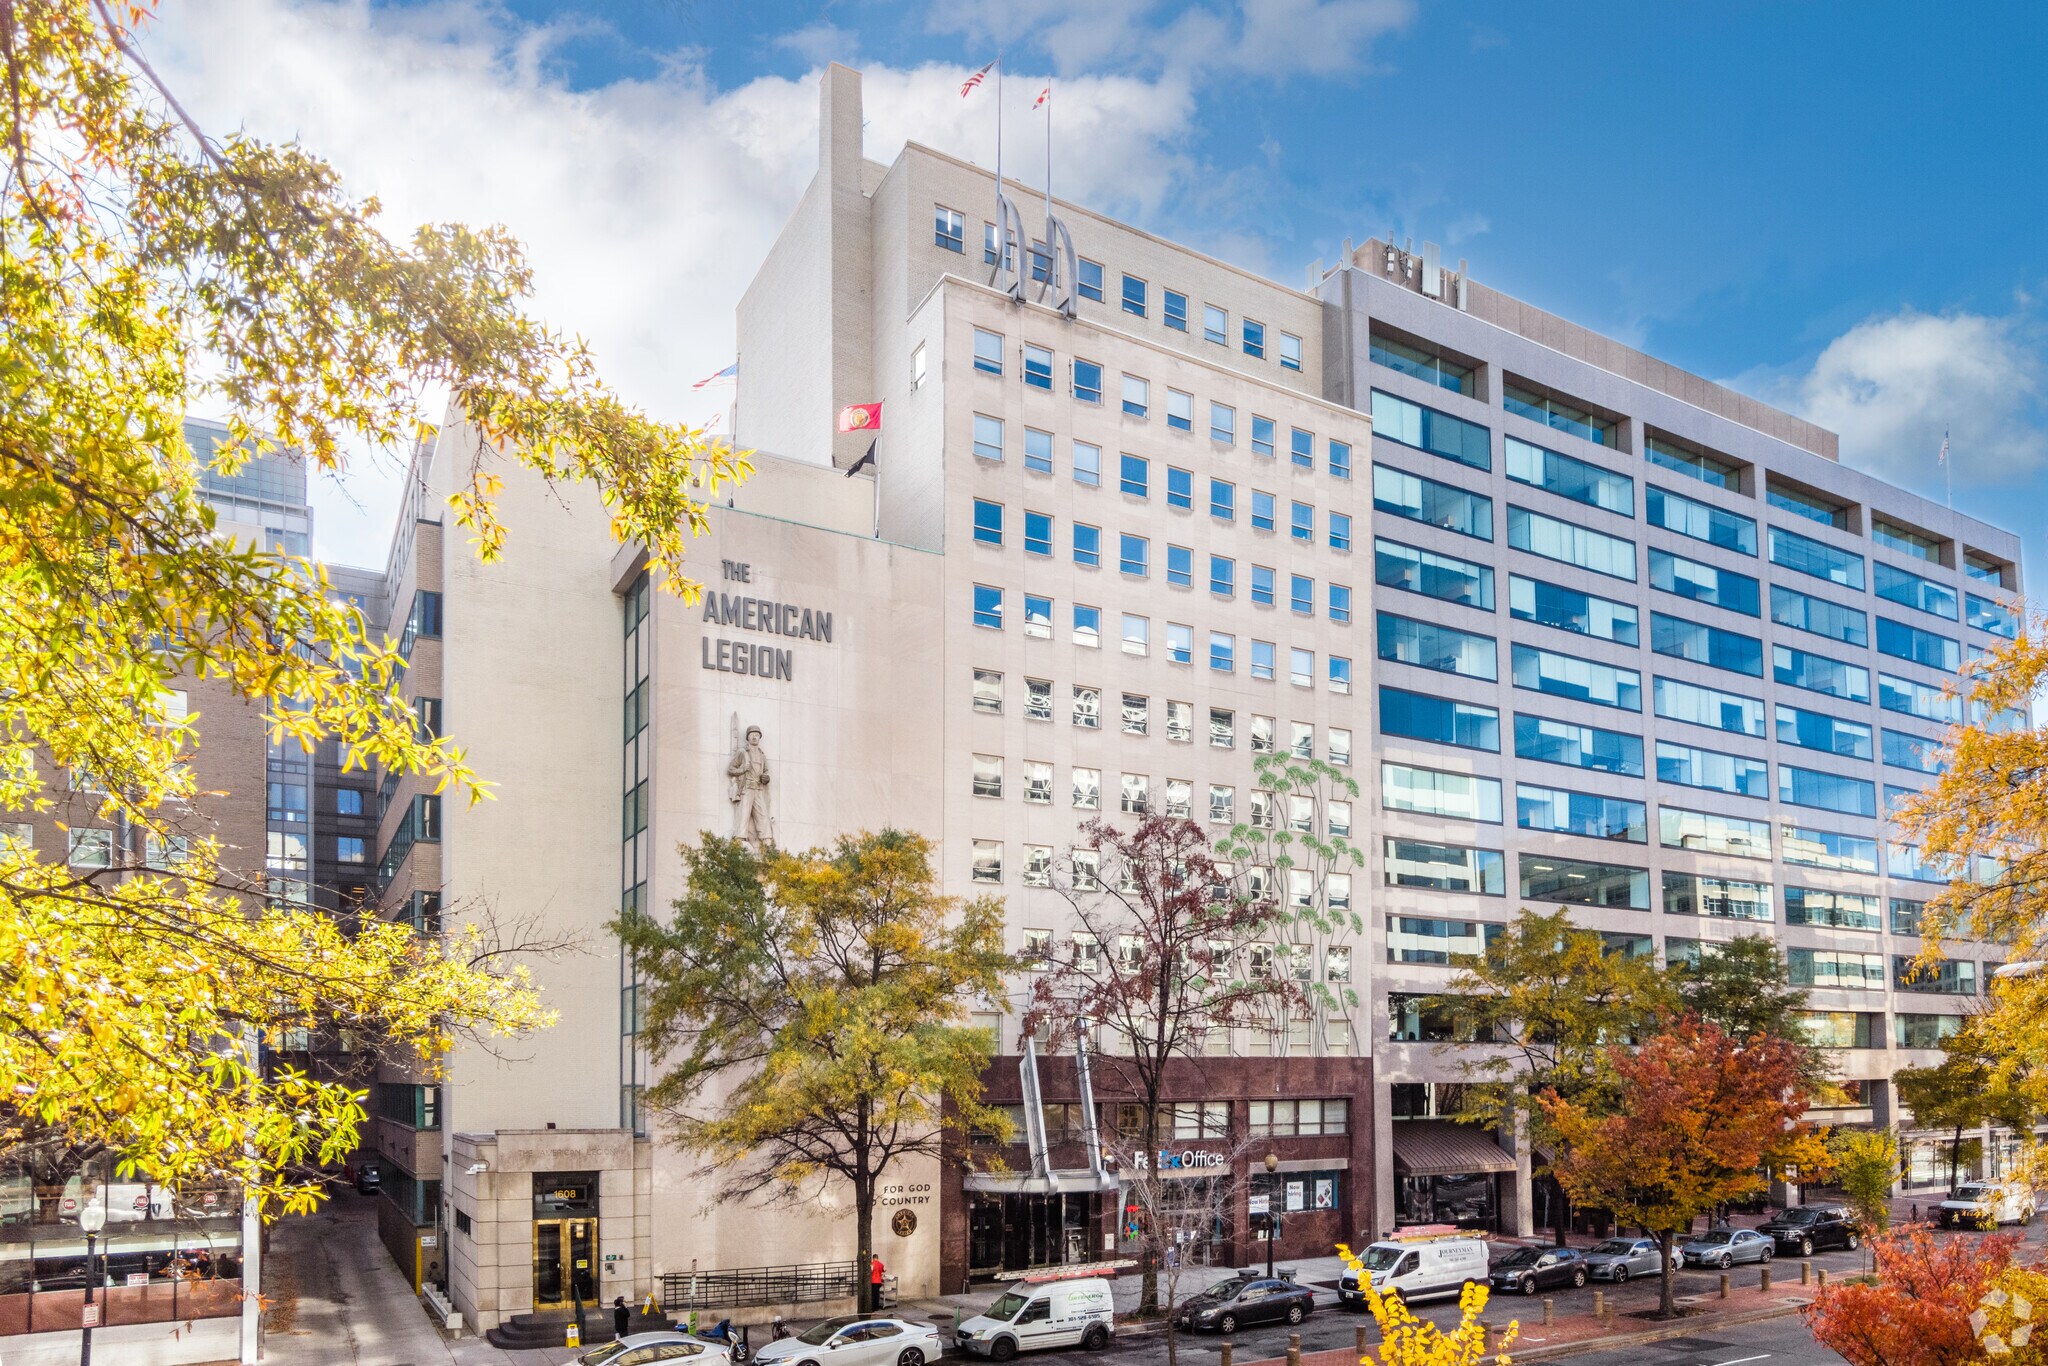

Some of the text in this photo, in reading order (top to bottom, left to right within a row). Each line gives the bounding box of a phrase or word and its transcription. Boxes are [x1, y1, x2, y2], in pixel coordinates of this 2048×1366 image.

[721, 559, 751, 584] THE
[702, 590, 833, 643] AMERICAN
[702, 636, 793, 682] LEGION
[1181, 1150, 1224, 1168] Office
[554, 1189, 576, 1199] 1608
[883, 1183, 931, 1194] FOR GOD
[881, 1195, 931, 1206] COUNTRY
